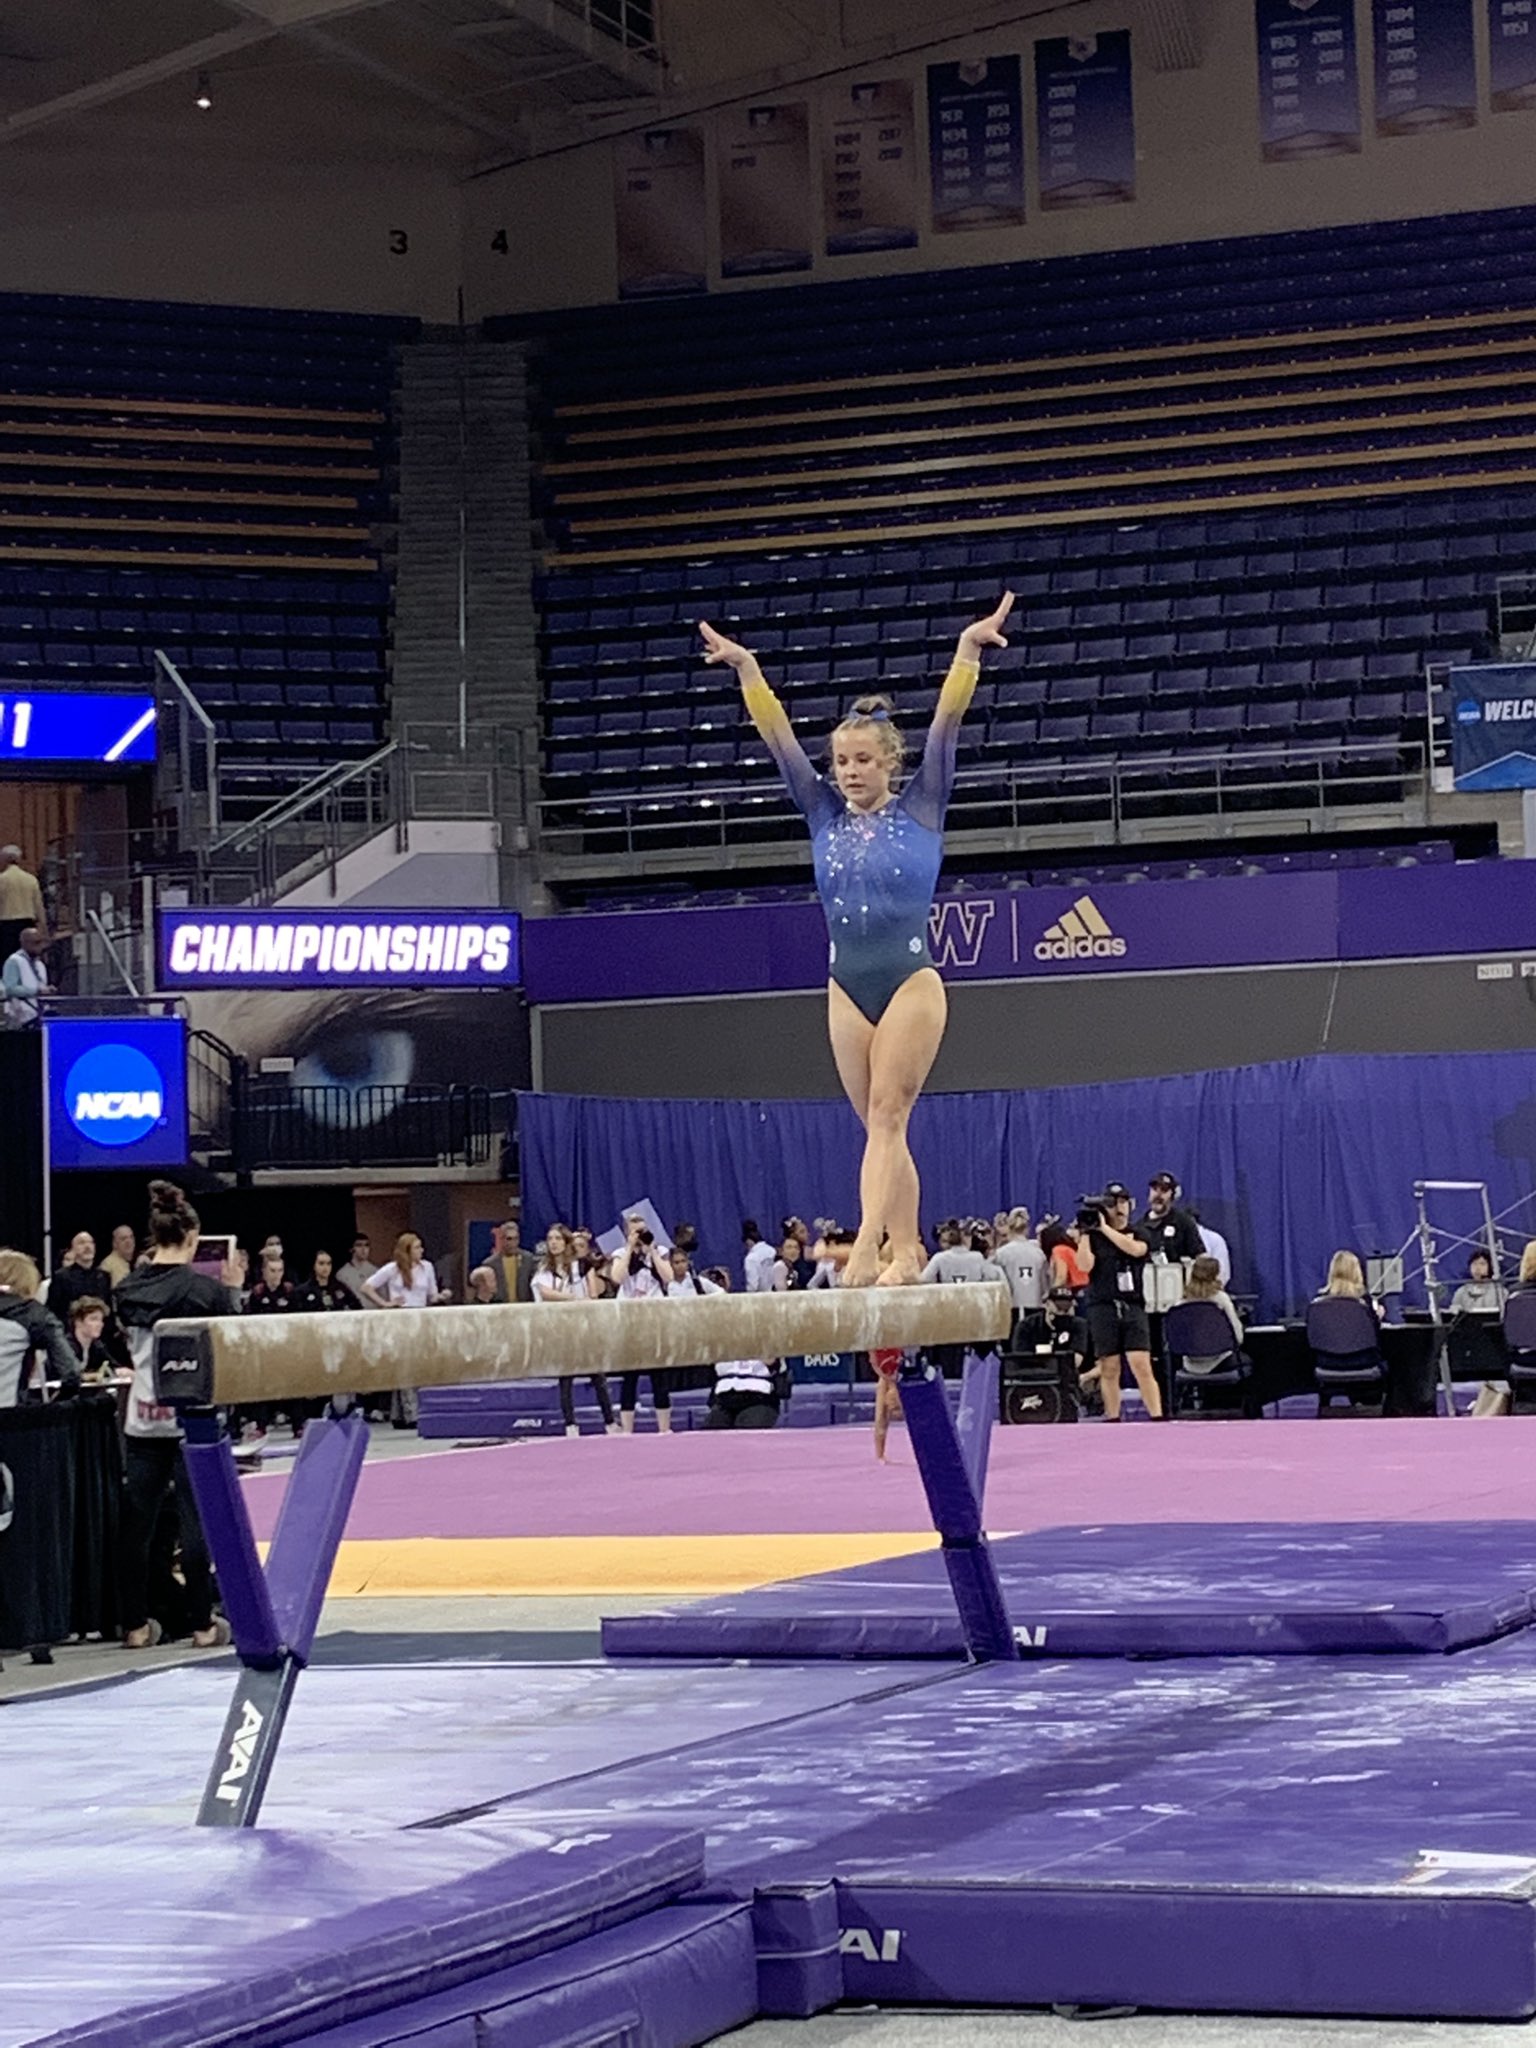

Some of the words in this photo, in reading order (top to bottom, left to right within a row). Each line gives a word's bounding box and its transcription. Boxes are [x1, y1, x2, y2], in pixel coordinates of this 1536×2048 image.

[390, 230, 408, 255] 3
[491, 229, 509, 255] 4
[1485, 699, 1536, 723] WELC
[928, 899, 995, 967] W
[169, 924, 511, 972] CHAMPIONSHIPS
[1034, 935, 1127, 960] adidas
[75, 1091, 161, 1120] NCAA
